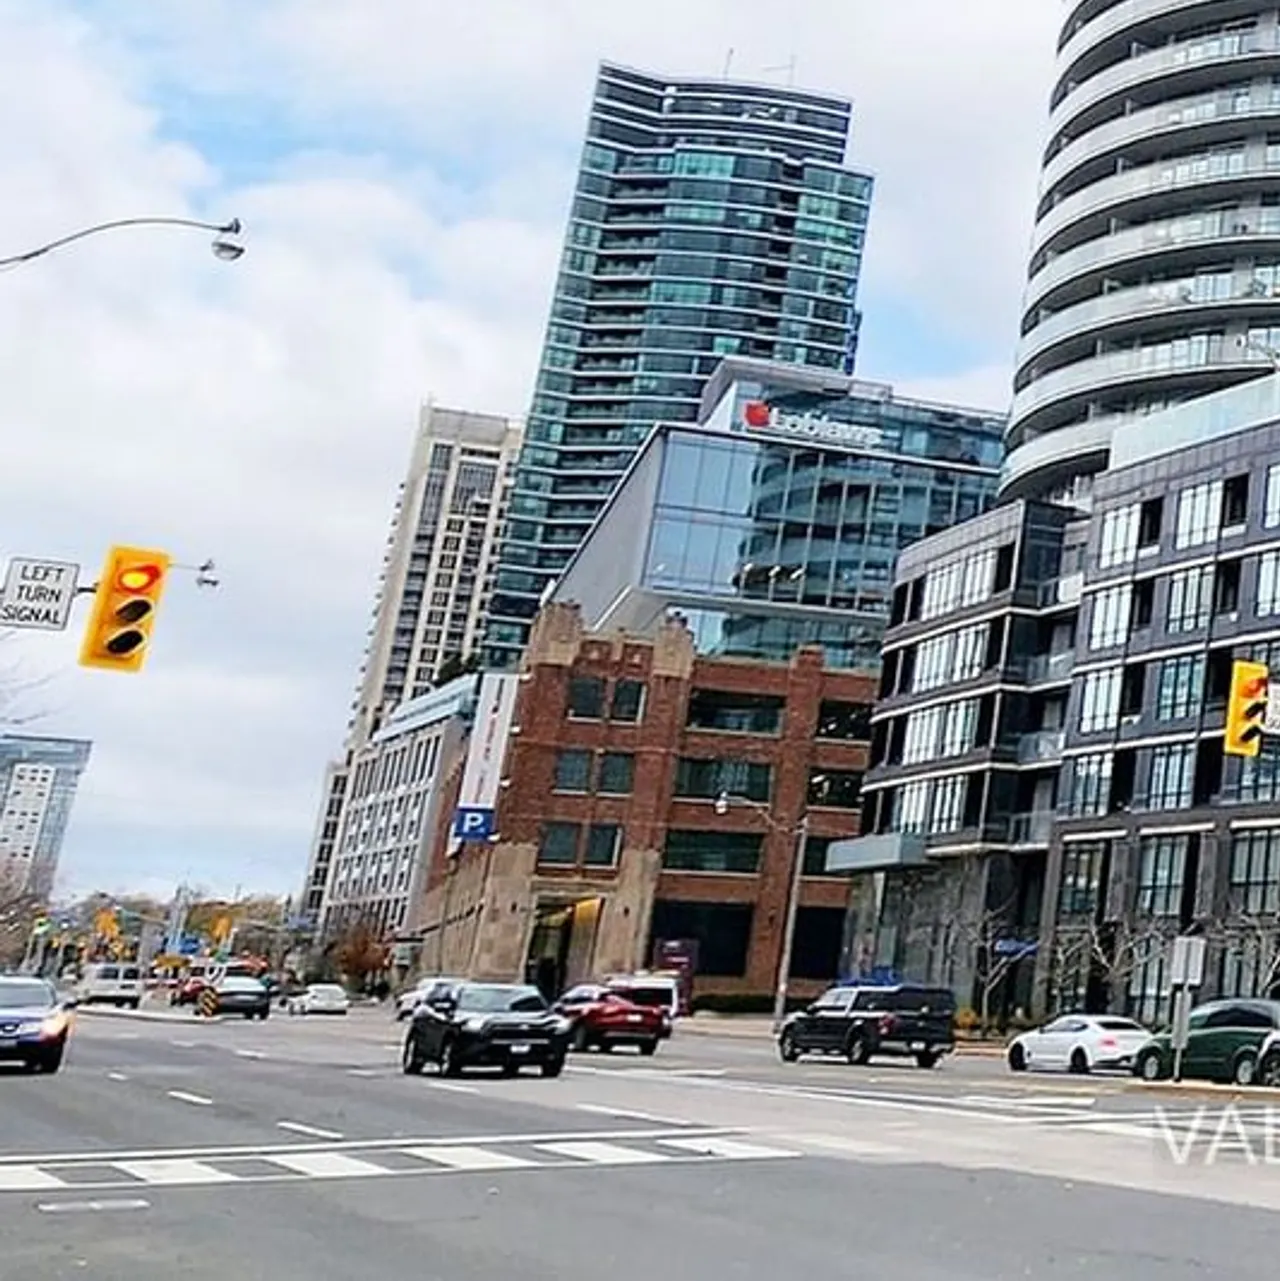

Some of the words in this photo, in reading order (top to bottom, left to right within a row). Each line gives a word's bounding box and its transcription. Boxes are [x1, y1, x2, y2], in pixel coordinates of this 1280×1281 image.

[21, 565, 65, 581] LEFT
[17, 585, 61, 602] TURN
[2, 604, 61, 624] SIGNAL
